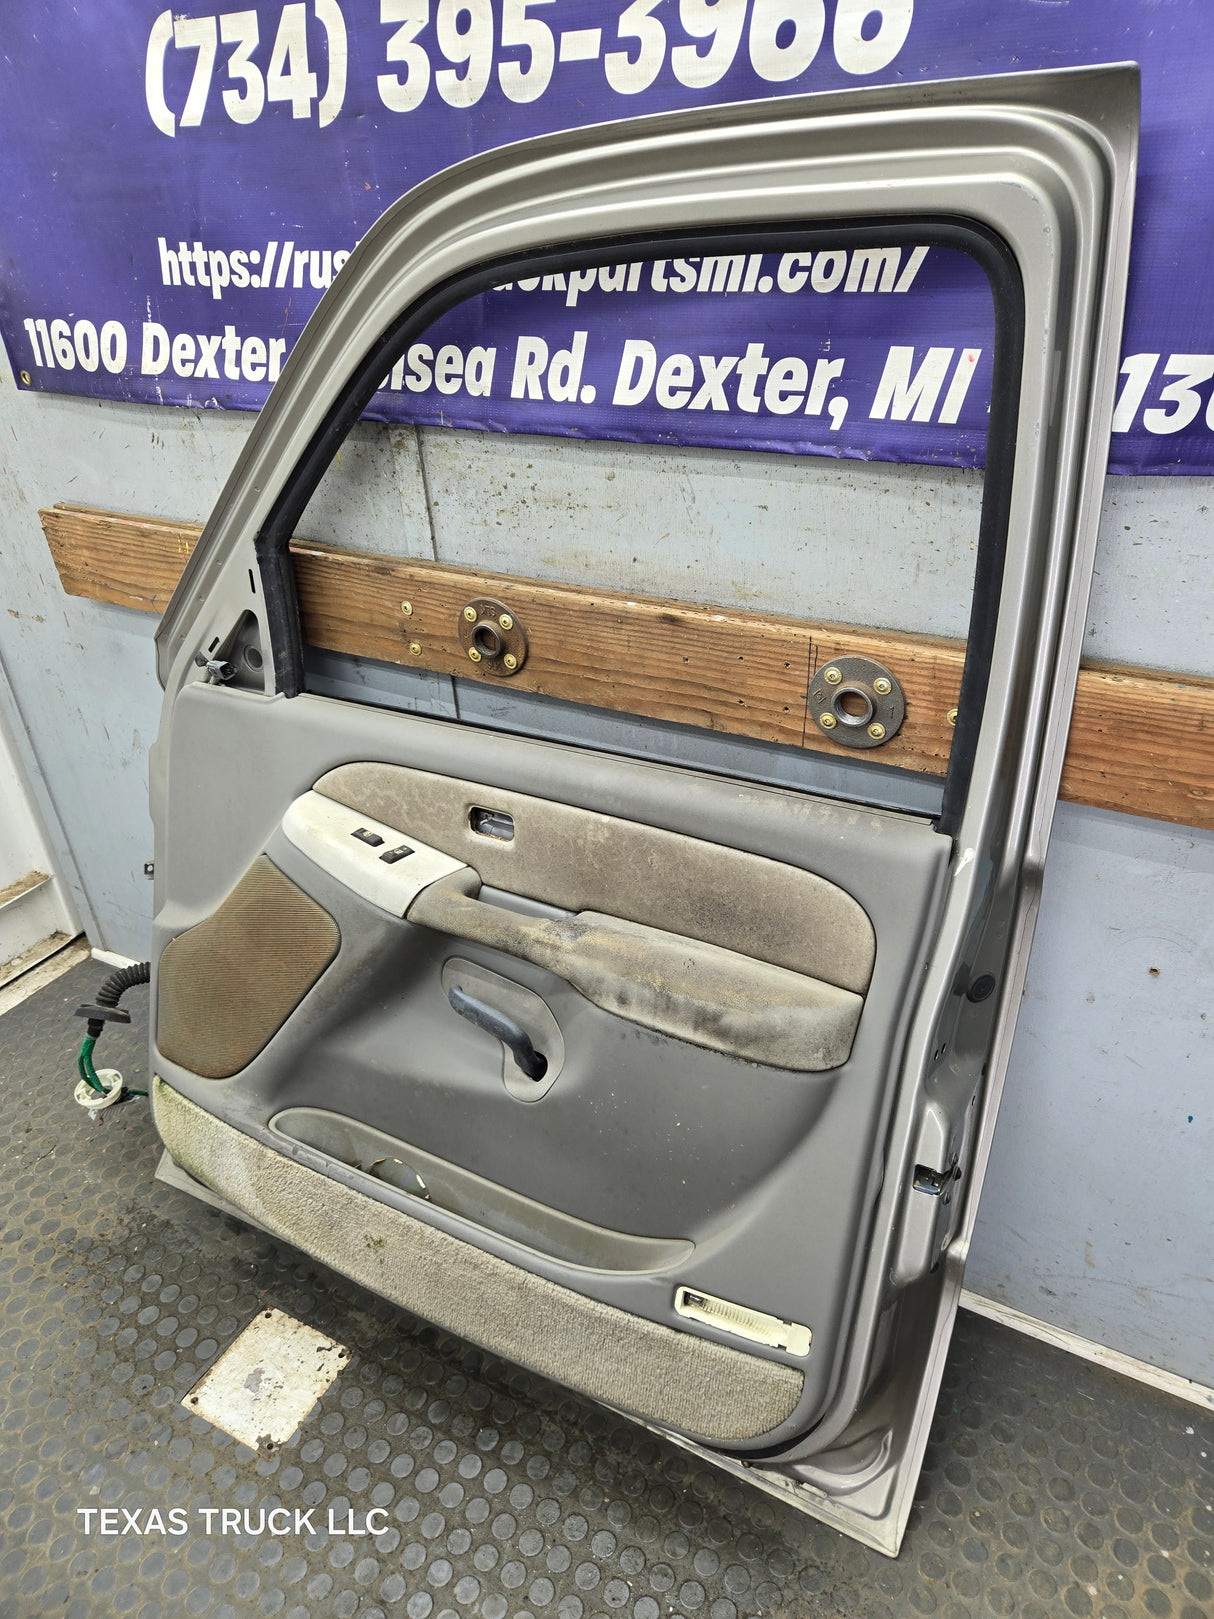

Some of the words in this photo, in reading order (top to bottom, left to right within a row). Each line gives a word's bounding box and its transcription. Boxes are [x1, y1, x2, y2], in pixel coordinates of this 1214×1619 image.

[145, 0, 348, 137] (734)
[23, 317, 128, 373] 11600
[510, 330, 597, 404] Rd.
[612, 339, 847, 431] Dexter,
[869, 346, 982, 424] MI
